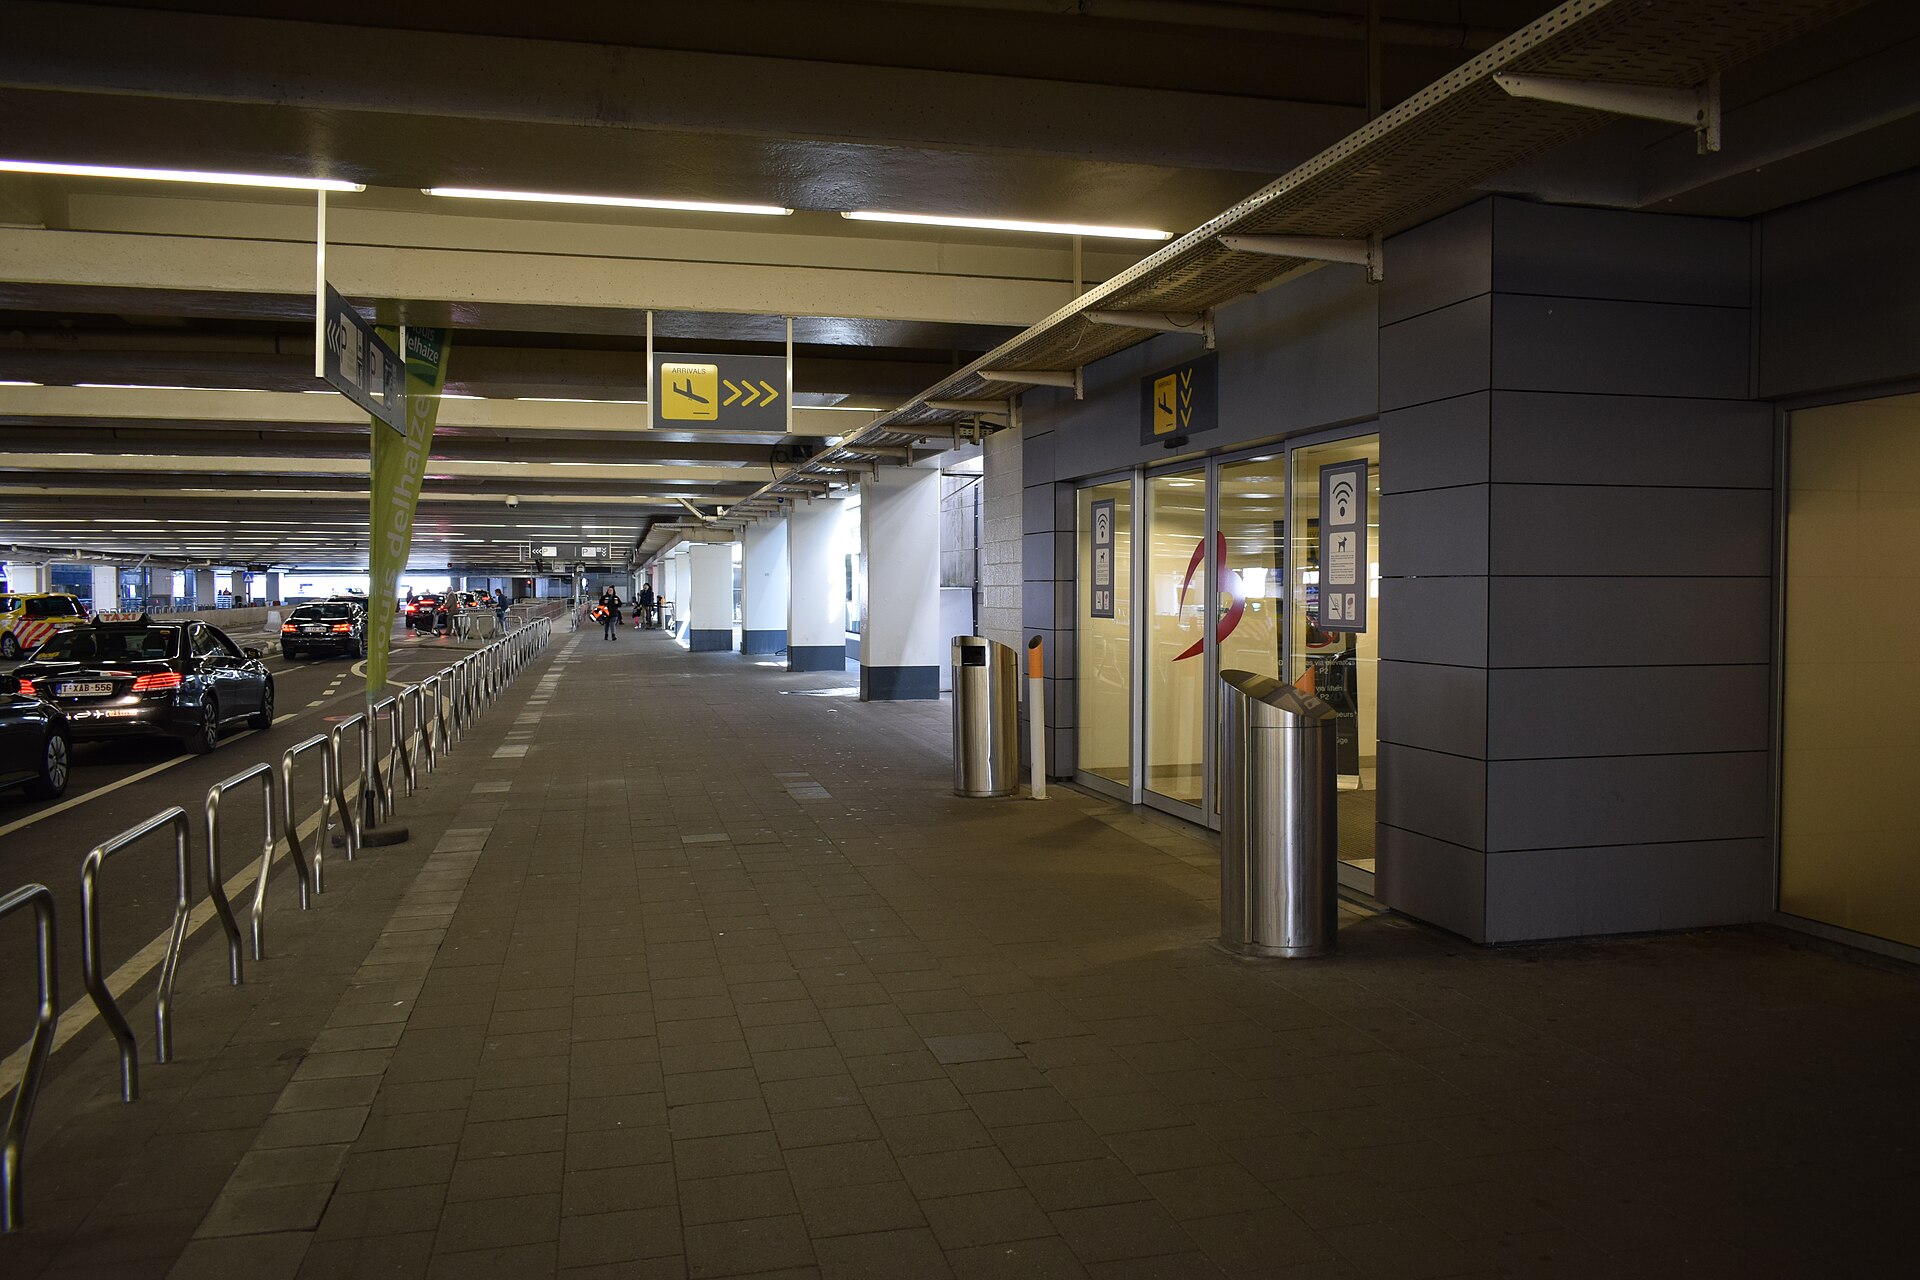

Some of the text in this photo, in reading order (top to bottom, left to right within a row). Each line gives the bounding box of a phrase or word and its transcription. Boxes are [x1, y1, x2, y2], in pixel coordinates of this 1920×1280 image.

[671, 367, 707, 375] ARRIVALS
[387, 396, 430, 558] delhaize
[103, 613, 138, 622] TAXI
